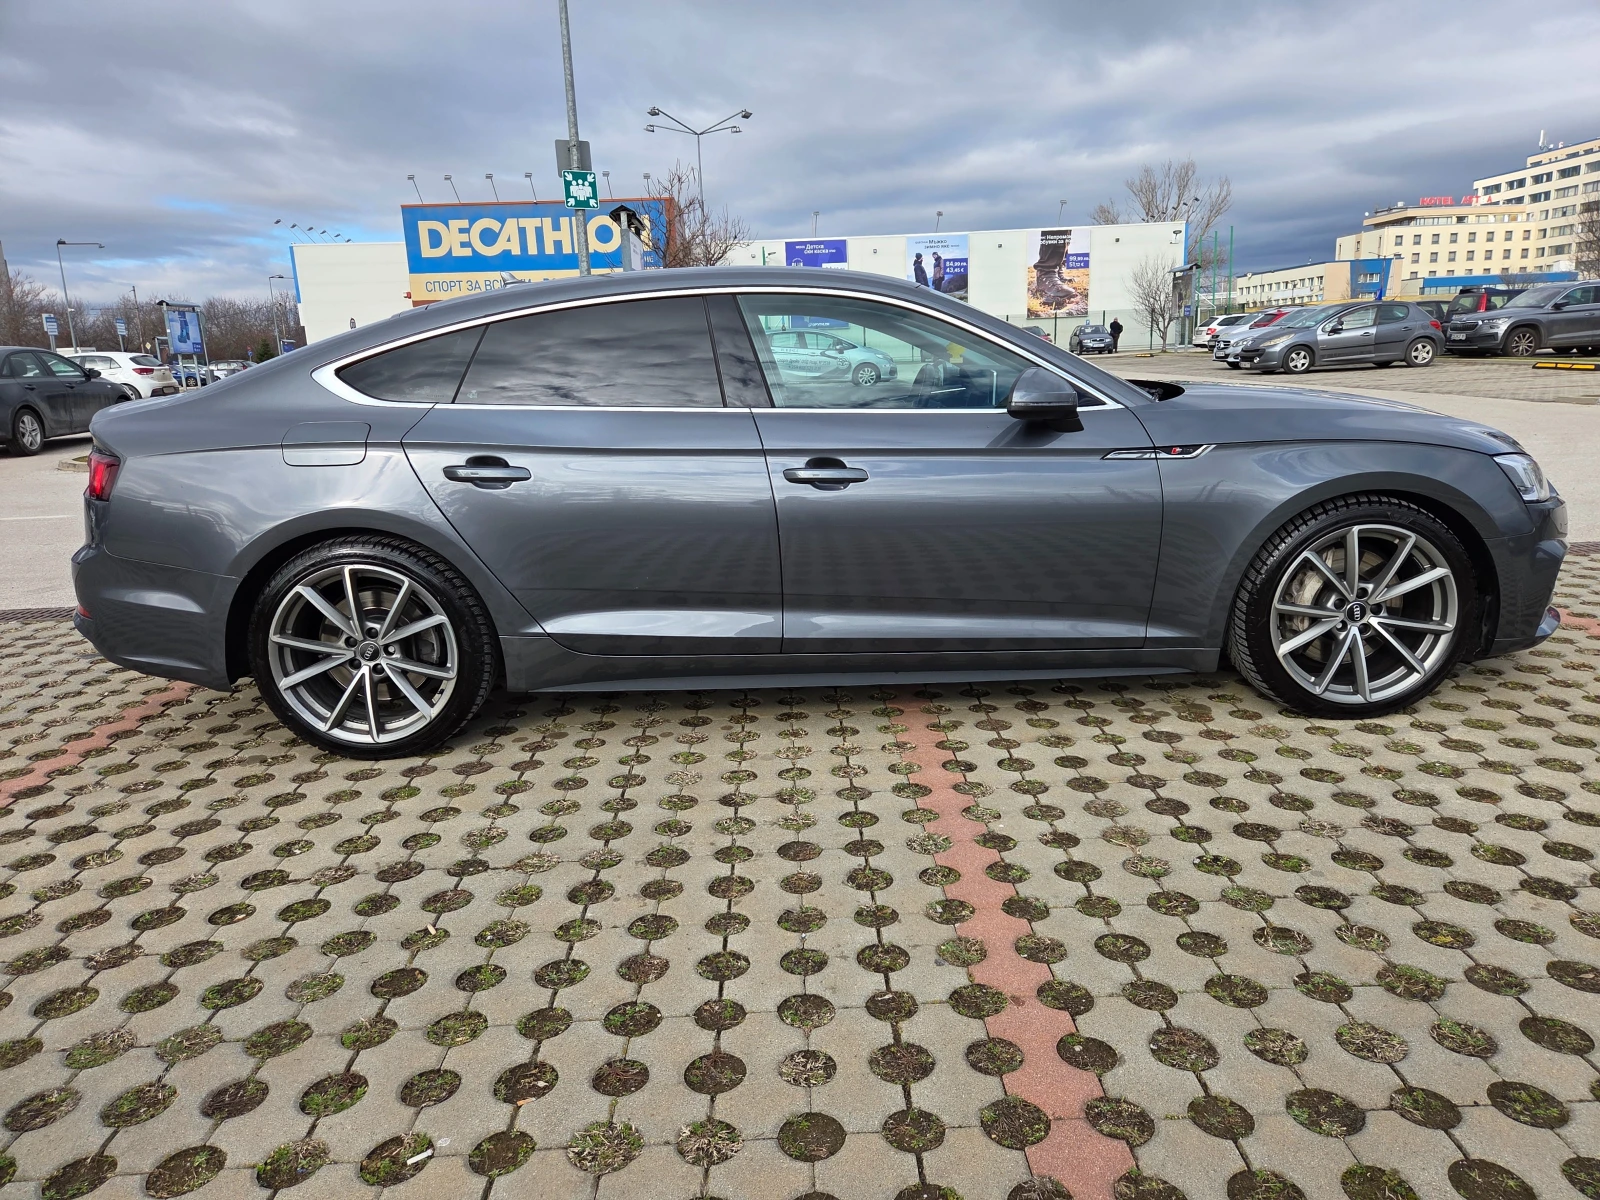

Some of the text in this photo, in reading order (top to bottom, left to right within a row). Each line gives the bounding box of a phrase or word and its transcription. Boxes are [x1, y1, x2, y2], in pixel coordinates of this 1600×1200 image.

[1420, 197, 1455, 206] HOTEL
[425, 280, 463, 292] СПОРТ
[466, 280, 483, 291] ЗА
